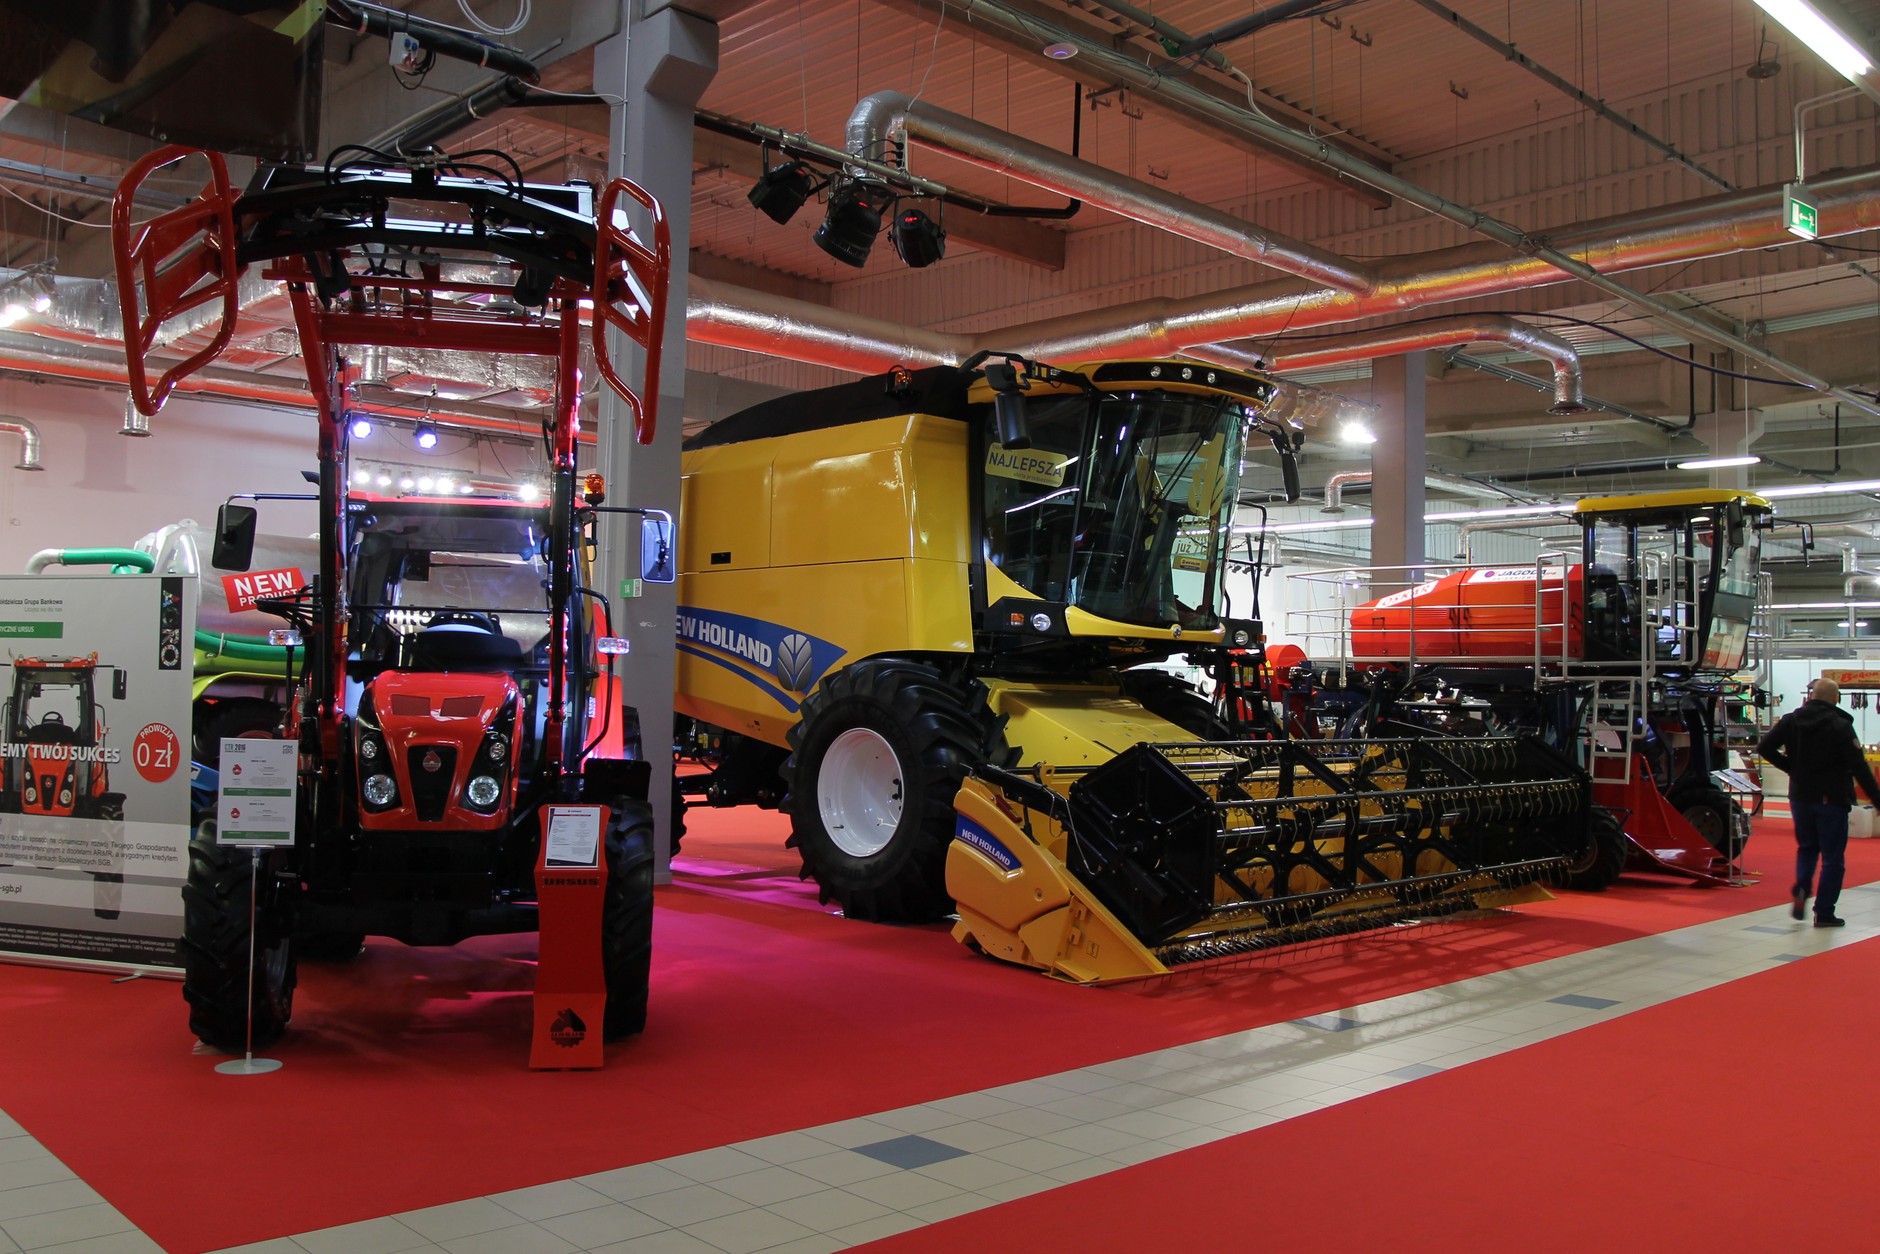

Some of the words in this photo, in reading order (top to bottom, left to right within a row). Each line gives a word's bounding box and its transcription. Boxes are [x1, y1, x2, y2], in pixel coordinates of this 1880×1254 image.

[988, 452, 1062, 478] NAJLEPSZA
[234, 572, 293, 596] NEW
[698, 621, 772, 668] HOLLAND
[139, 723, 174, 741] PROWIZJA
[0, 742, 29, 758] EMY
[32, 741, 68, 761] TWÓJ
[69, 746, 121, 763] SUKCES
[136, 742, 150, 767] 0
[154, 741, 173, 768] zł
[110, 841, 134, 851] Twojego
[135, 842, 177, 853] Gospodarstwa.
[120, 852, 150, 861] wygodnym
[151, 853, 178, 862] kredytem
[961, 829, 979, 844] NEW
[979, 839, 1011, 866] HOLLAND
